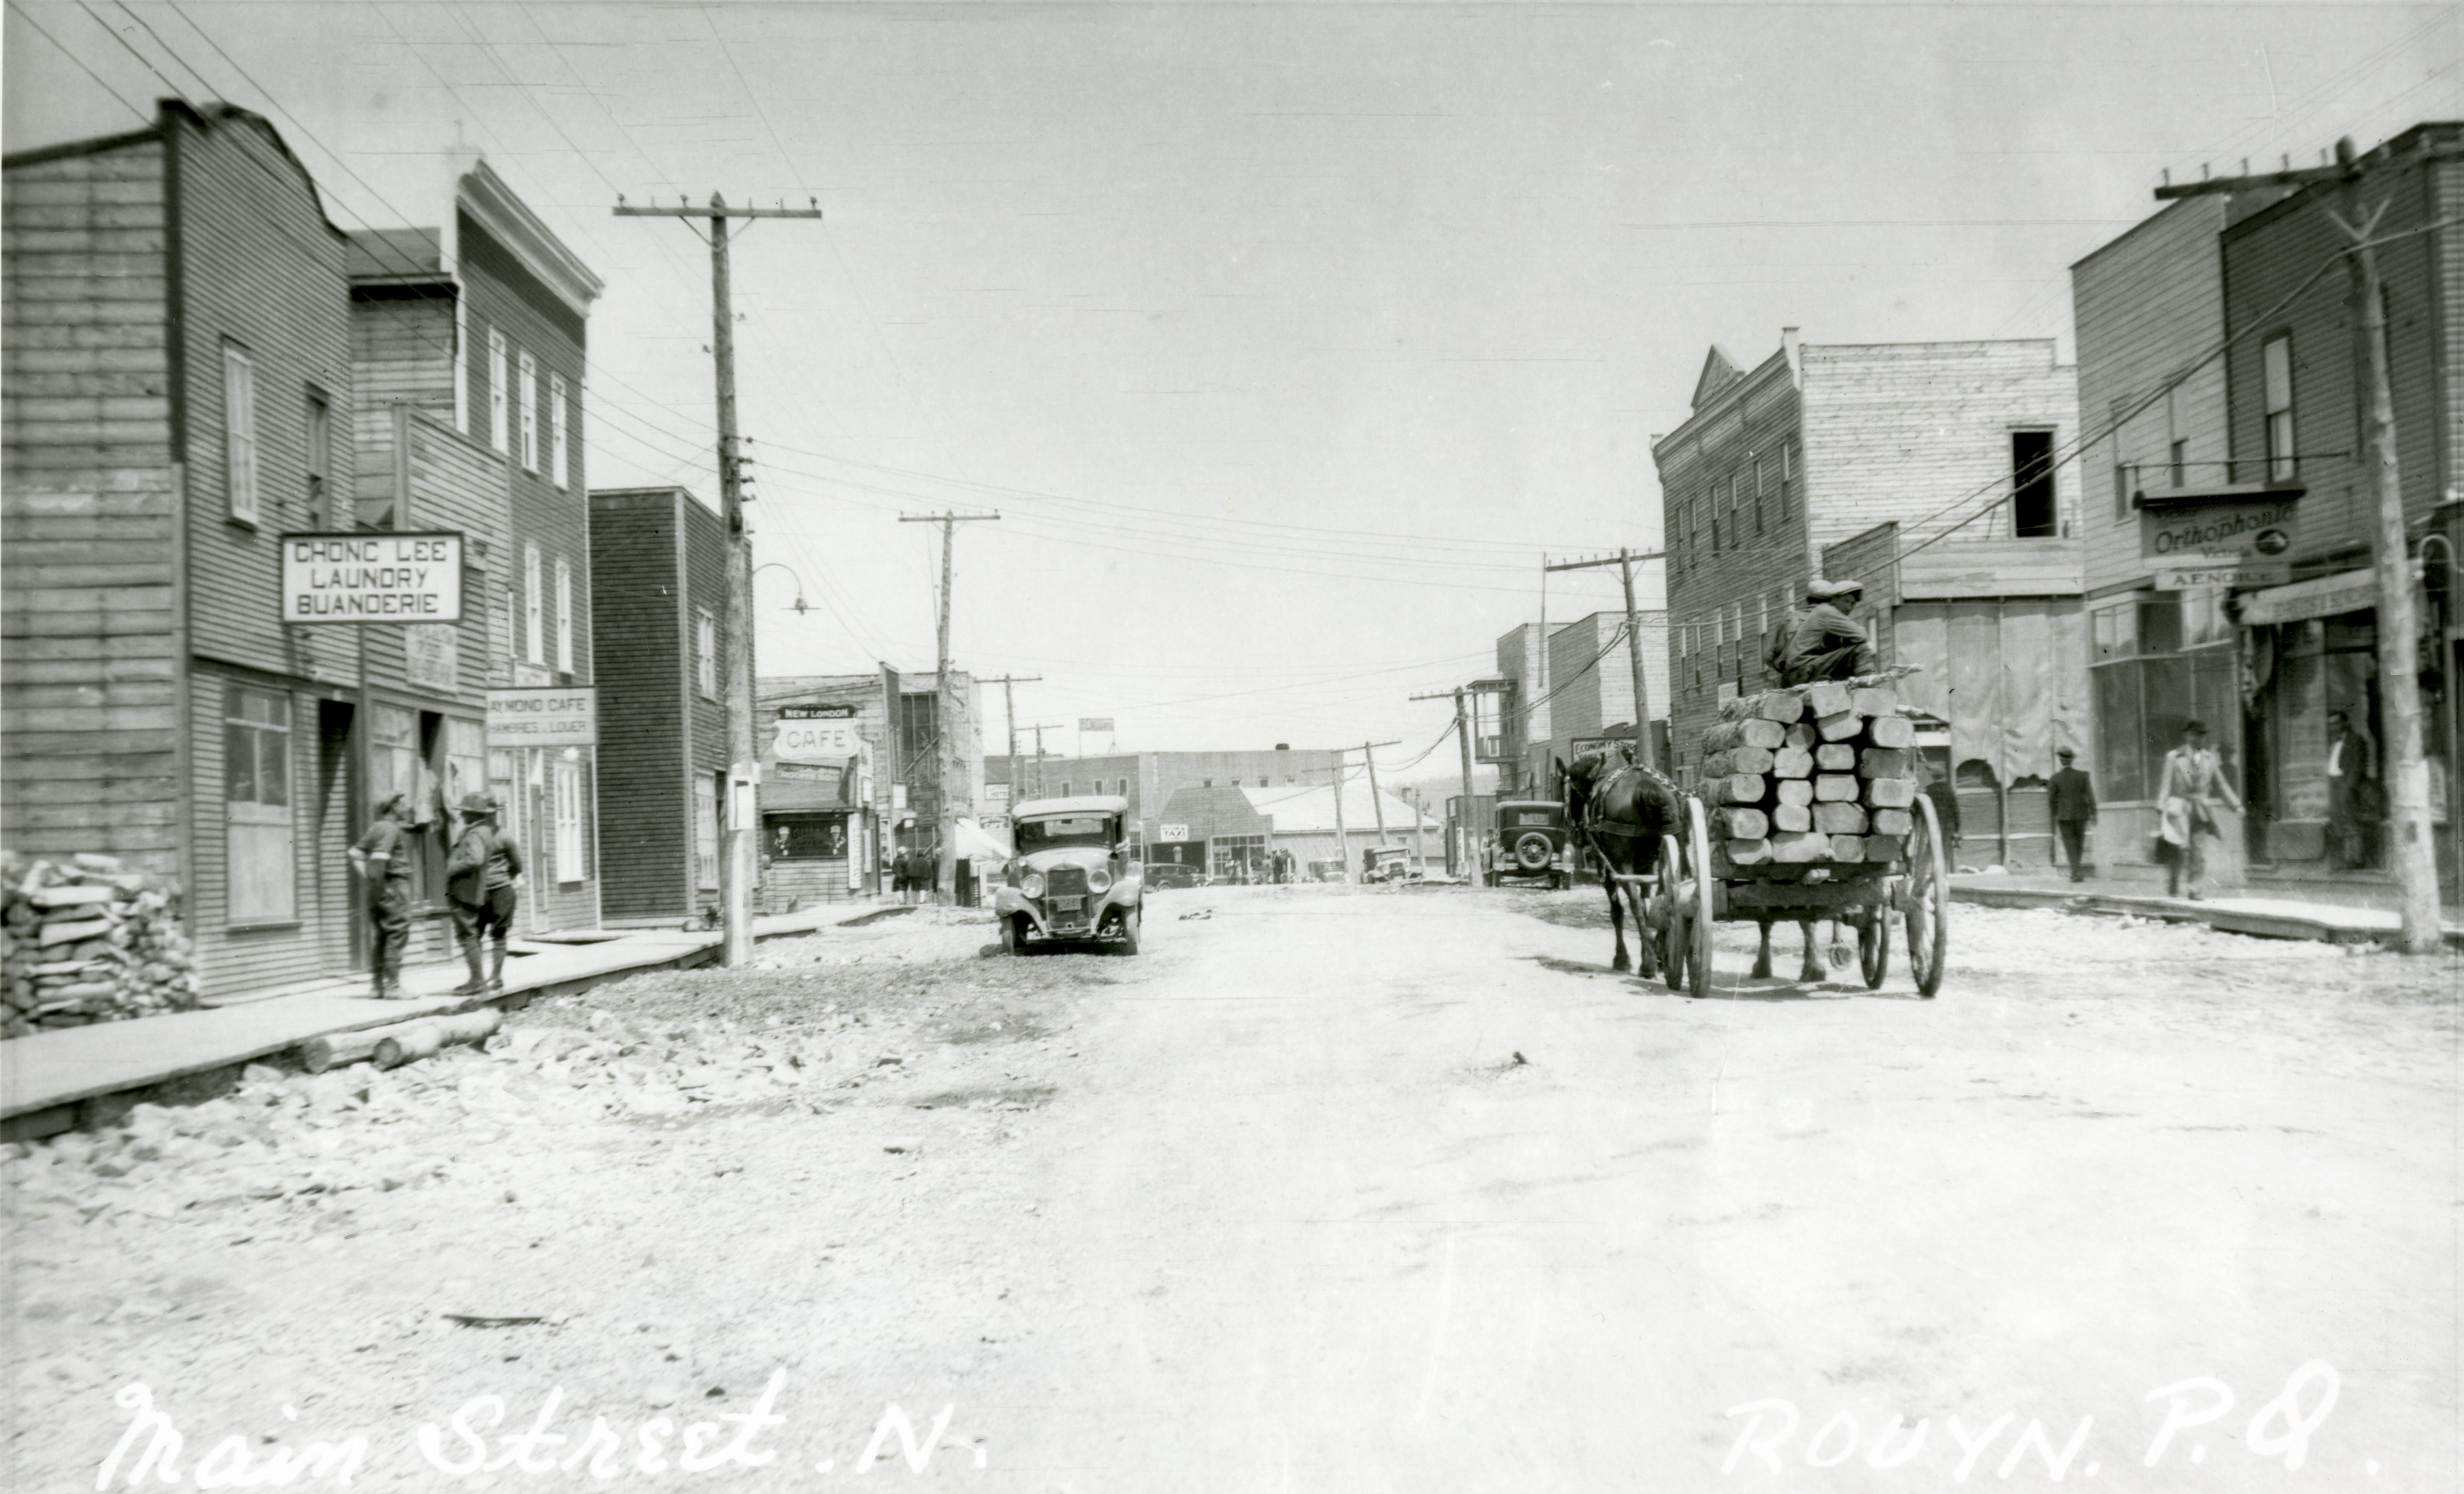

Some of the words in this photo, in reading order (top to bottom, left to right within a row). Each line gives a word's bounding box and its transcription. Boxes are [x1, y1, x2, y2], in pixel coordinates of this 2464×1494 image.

[2155, 503, 2295, 554] Orthophonic
[397, 541, 446, 562] LEE
[312, 568, 428, 589] LAUNDRY
[297, 594, 438, 615] BUANDERIE
[489, 698, 543, 713] AYMOND
[548, 697, 586, 712] CAFE
[785, 708, 808, 719] NEW
[810, 708, 848, 718] LONDON
[488, 722, 539, 733] HAMBRES
[550, 720, 586, 733] LOUER
[787, 730, 846, 748] CAFE
[1575, 741, 1613, 755] ECONOMY
